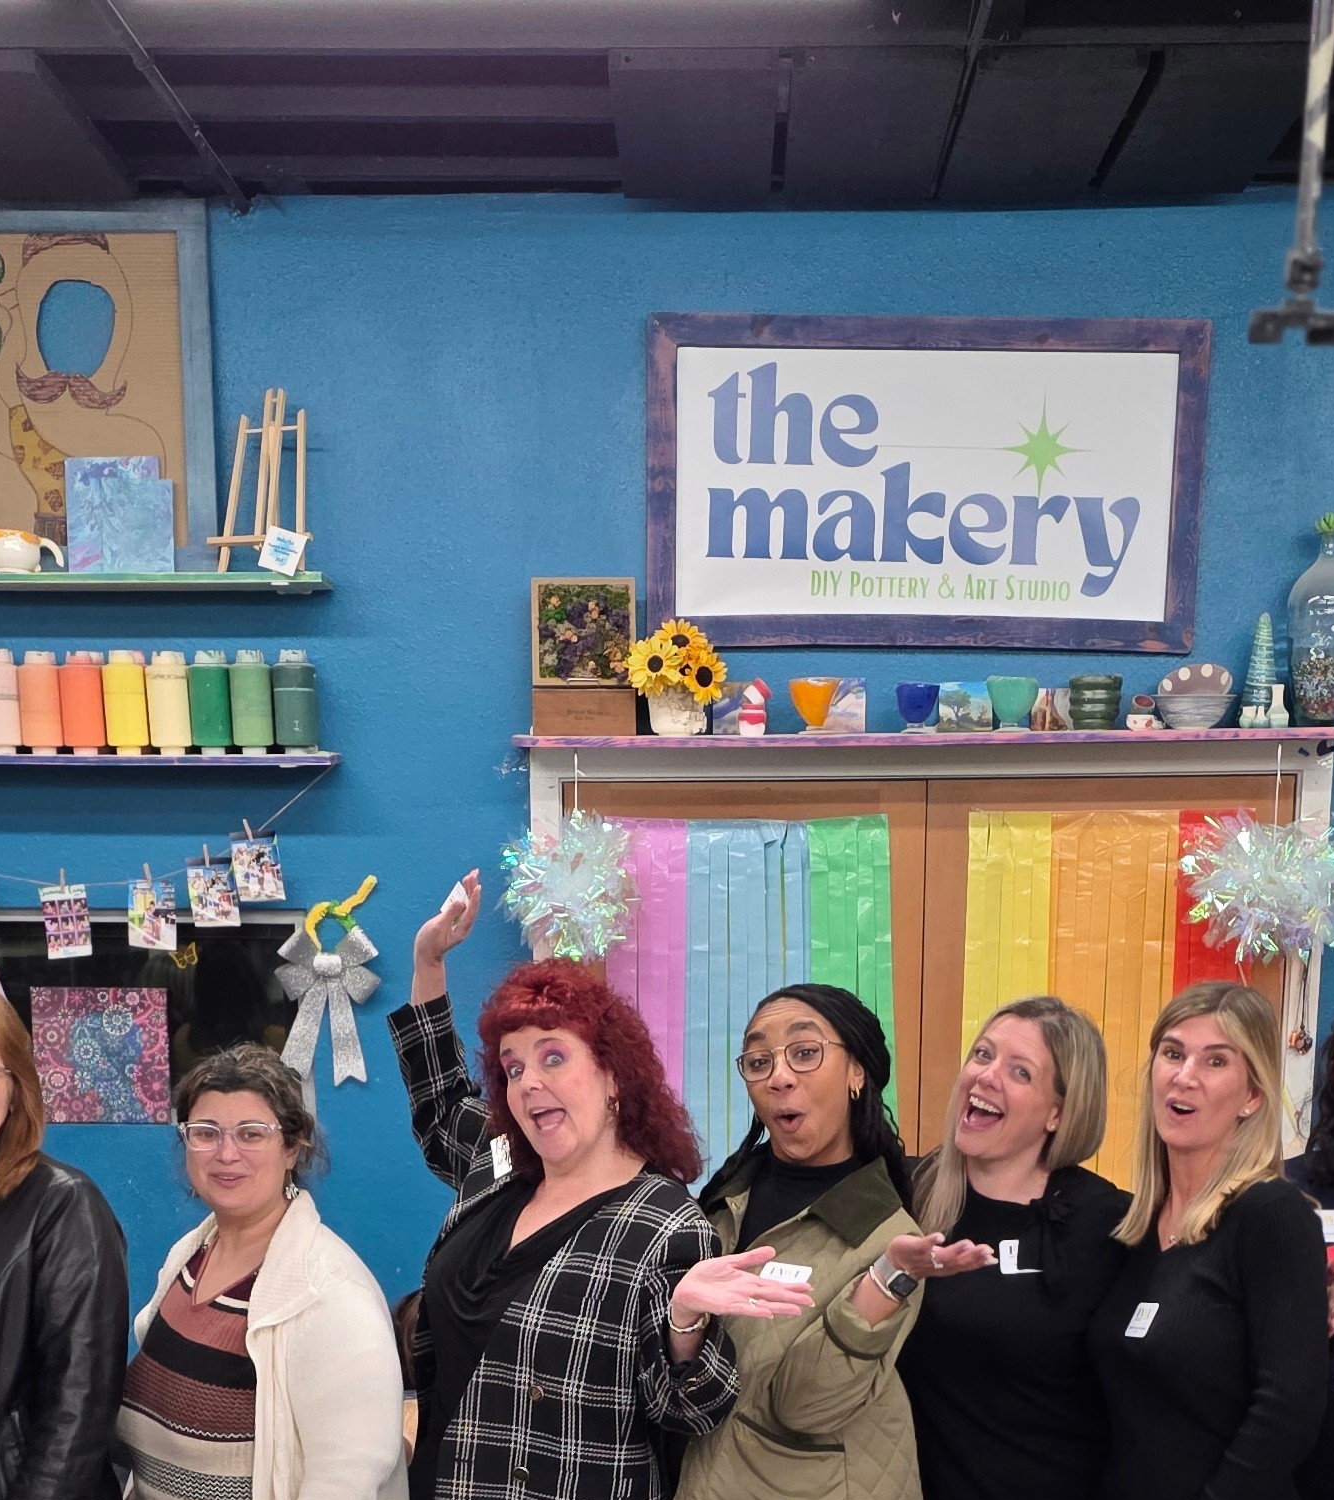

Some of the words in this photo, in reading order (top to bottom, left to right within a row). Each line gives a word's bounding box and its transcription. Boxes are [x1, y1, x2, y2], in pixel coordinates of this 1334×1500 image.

[708, 362, 879, 467] the
[705, 462, 1141, 597] makery
[810, 569, 843, 597] DIY
[938, 573, 955, 600] &
